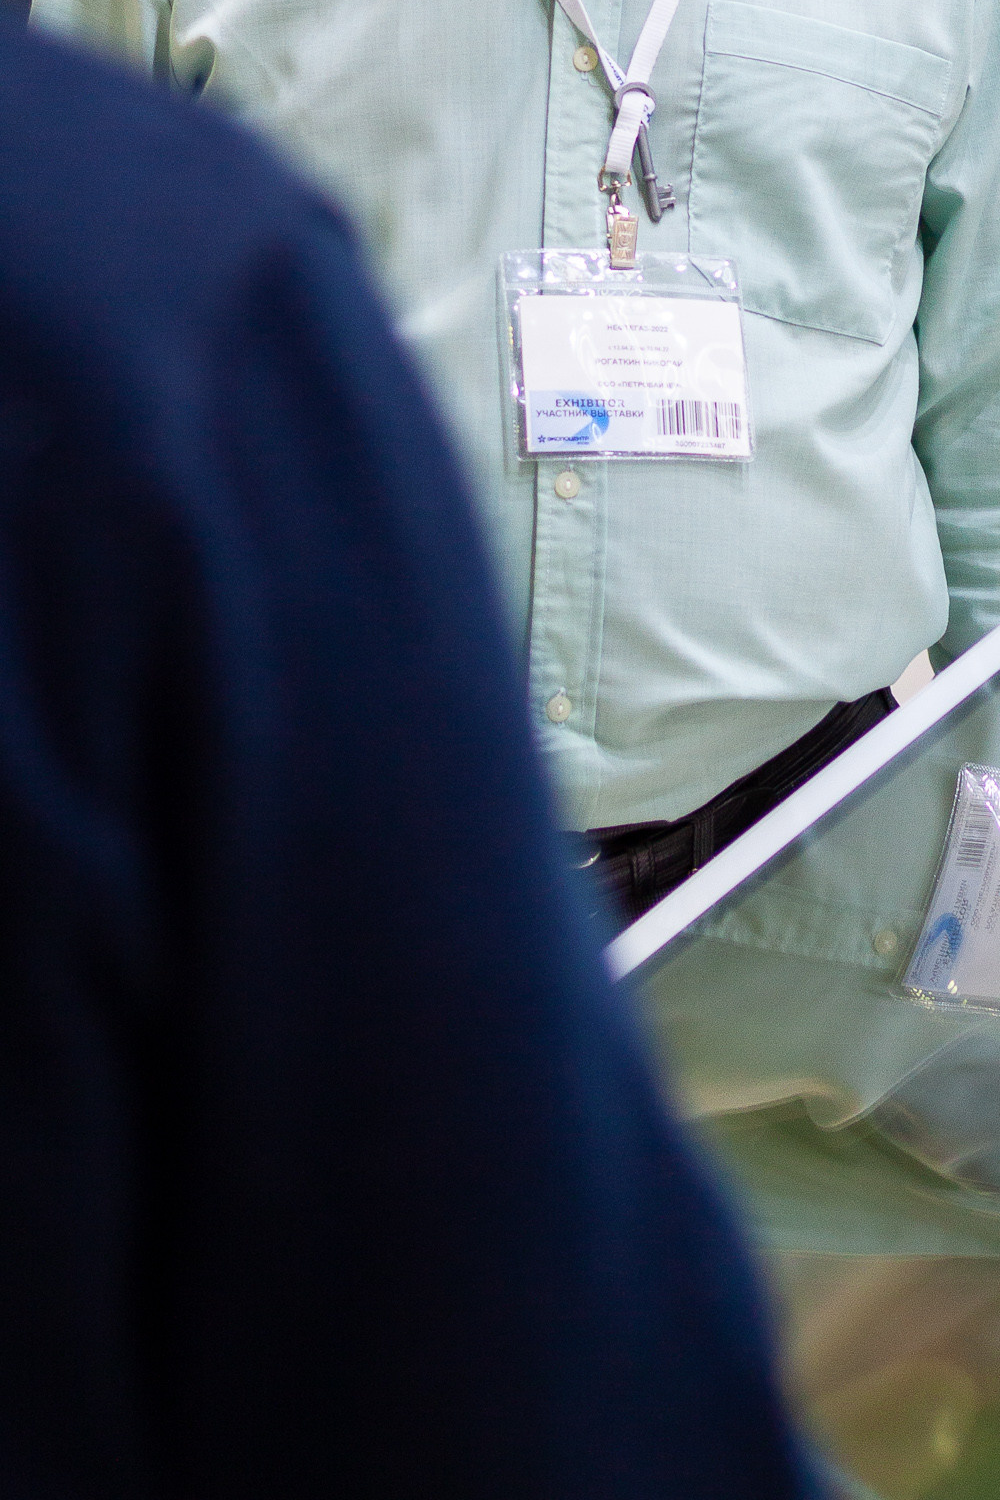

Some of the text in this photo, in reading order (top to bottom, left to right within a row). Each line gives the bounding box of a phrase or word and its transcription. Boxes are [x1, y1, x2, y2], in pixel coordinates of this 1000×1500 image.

[555, 399, 625, 408] EXHIBITOR
[536, 410, 644, 418] УЧАСТНИК ВЫСТАВКИ
